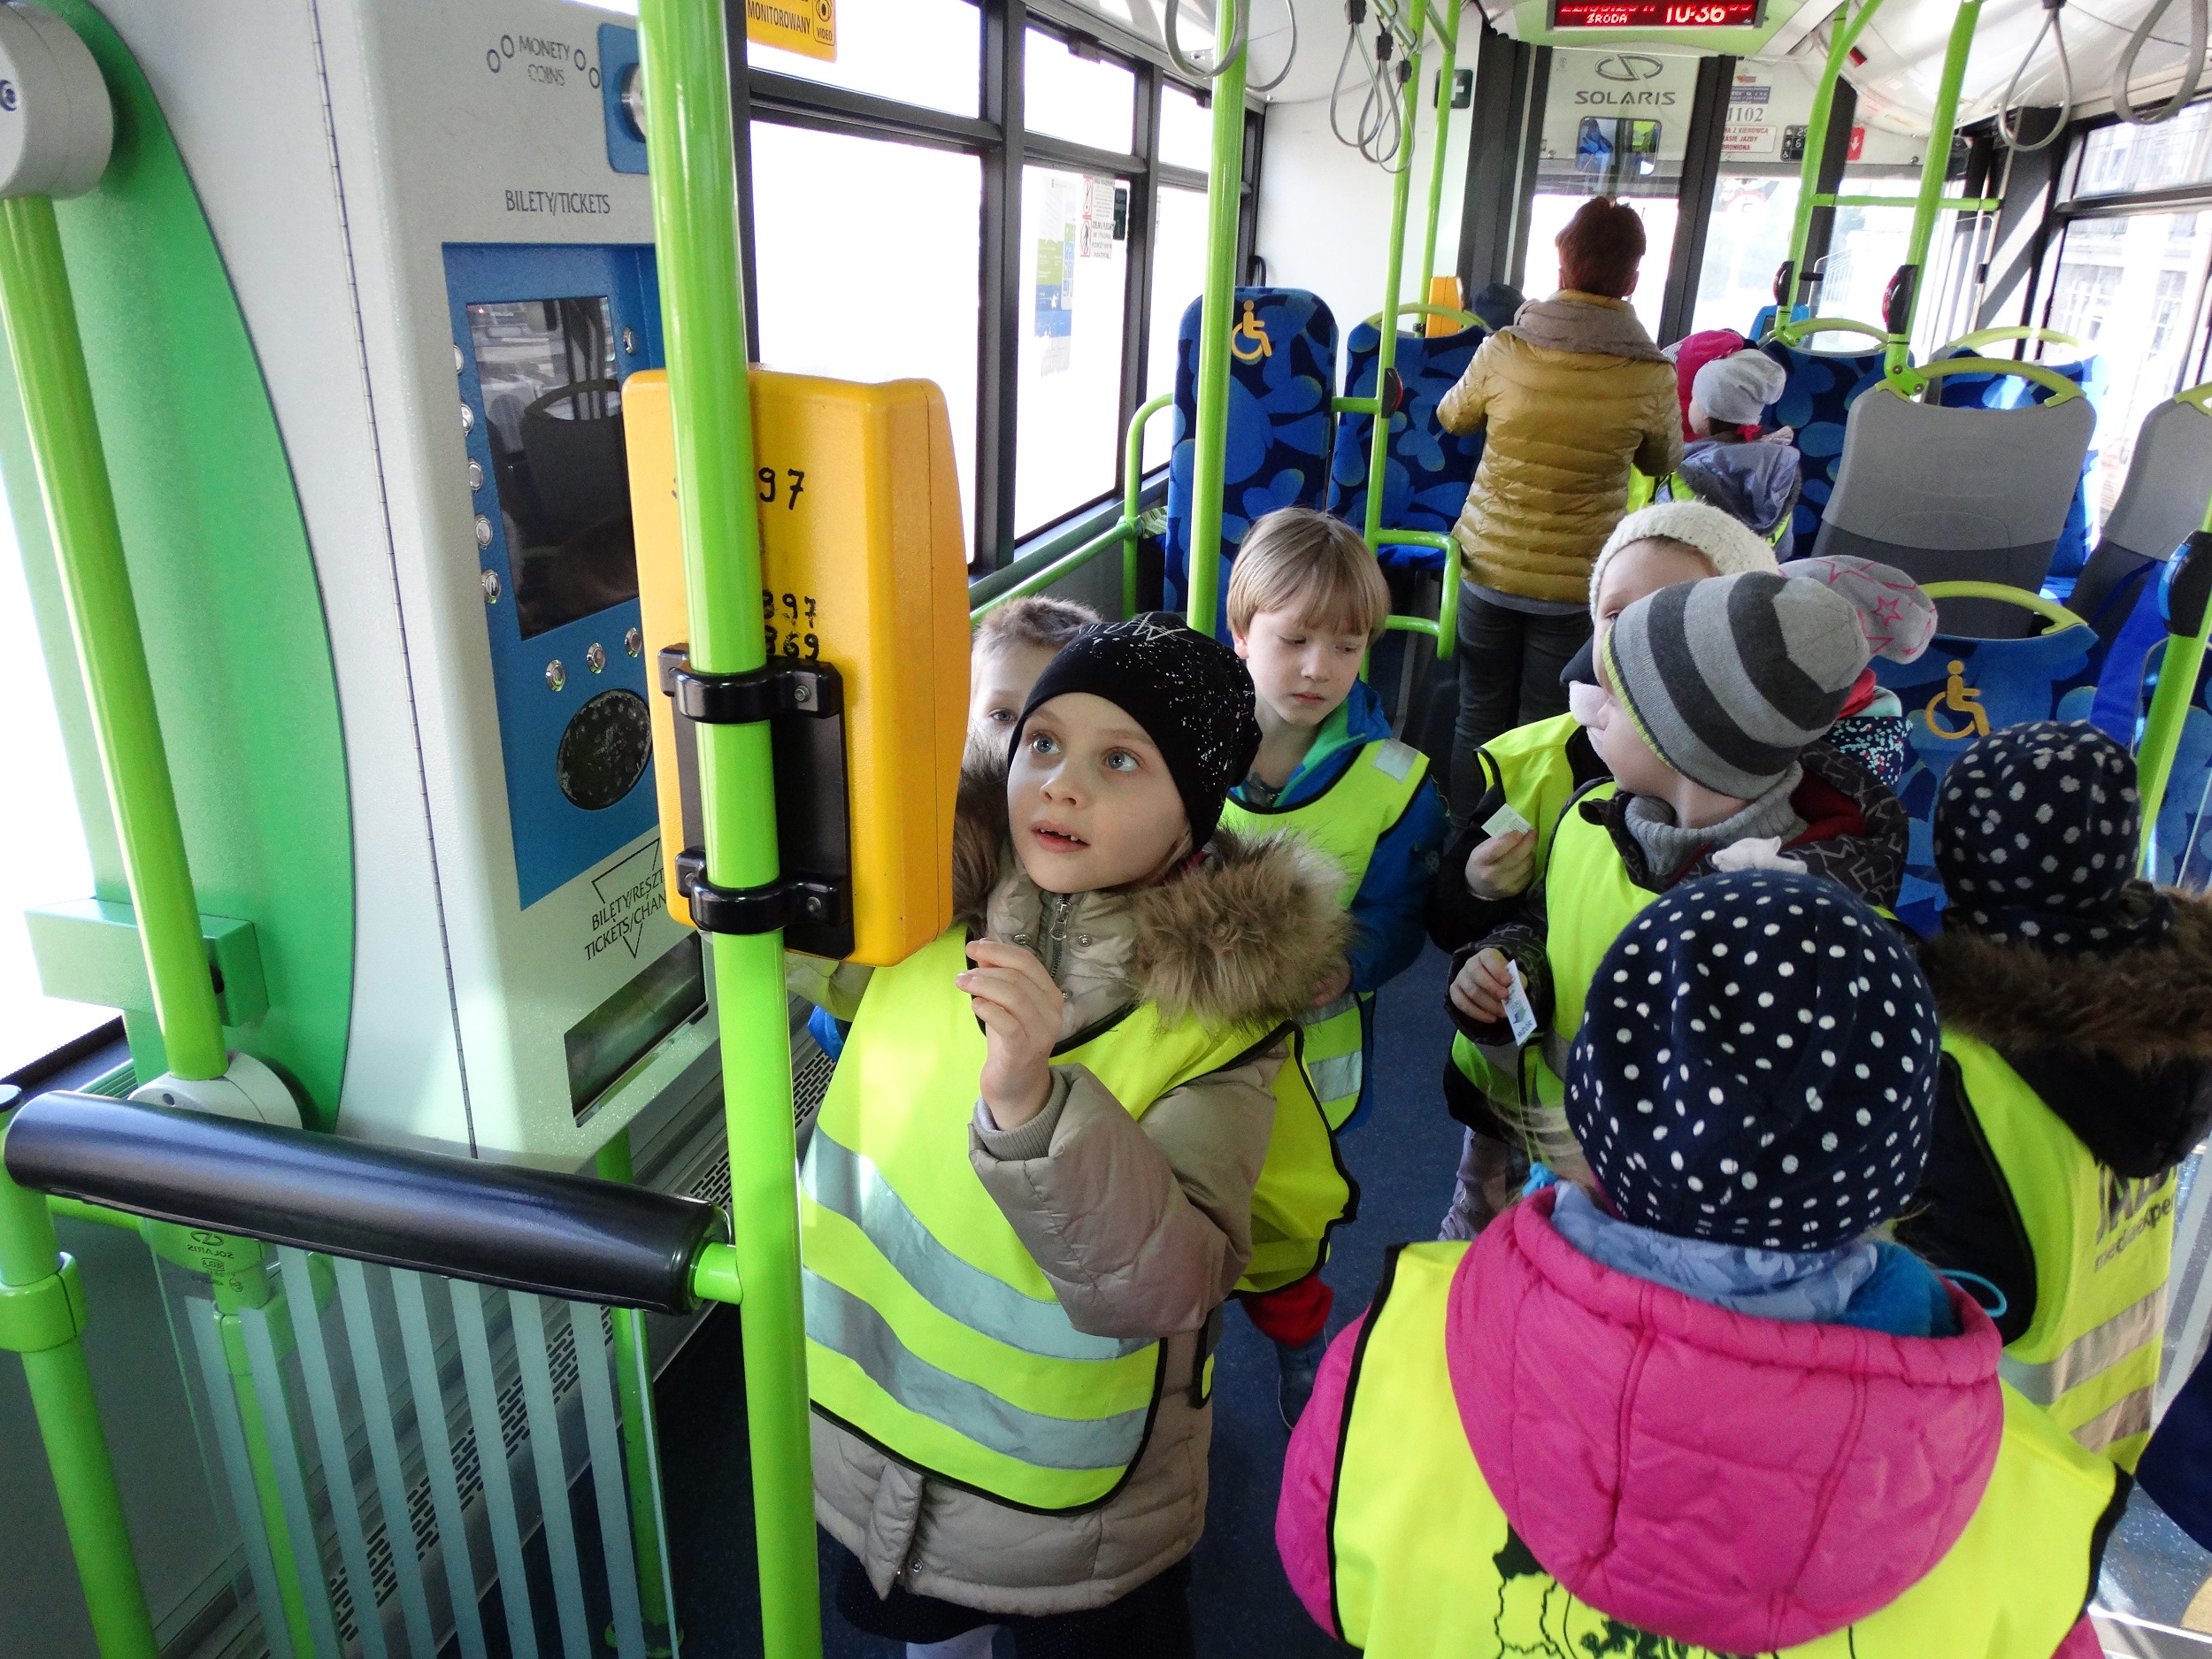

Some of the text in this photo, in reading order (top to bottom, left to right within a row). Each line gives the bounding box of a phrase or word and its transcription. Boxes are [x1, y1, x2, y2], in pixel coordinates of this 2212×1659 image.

[747, 1, 810, 35] MONITOROWANY
[817, 27, 832, 41] VIDEO
[518, 35, 570, 61] MONETY
[527, 64, 565, 87] COINS
[1574, 90, 1676, 106] SOLARIS
[1726, 107, 1764, 122] 1102
[505, 189, 611, 216] BILETY/TICKETS
